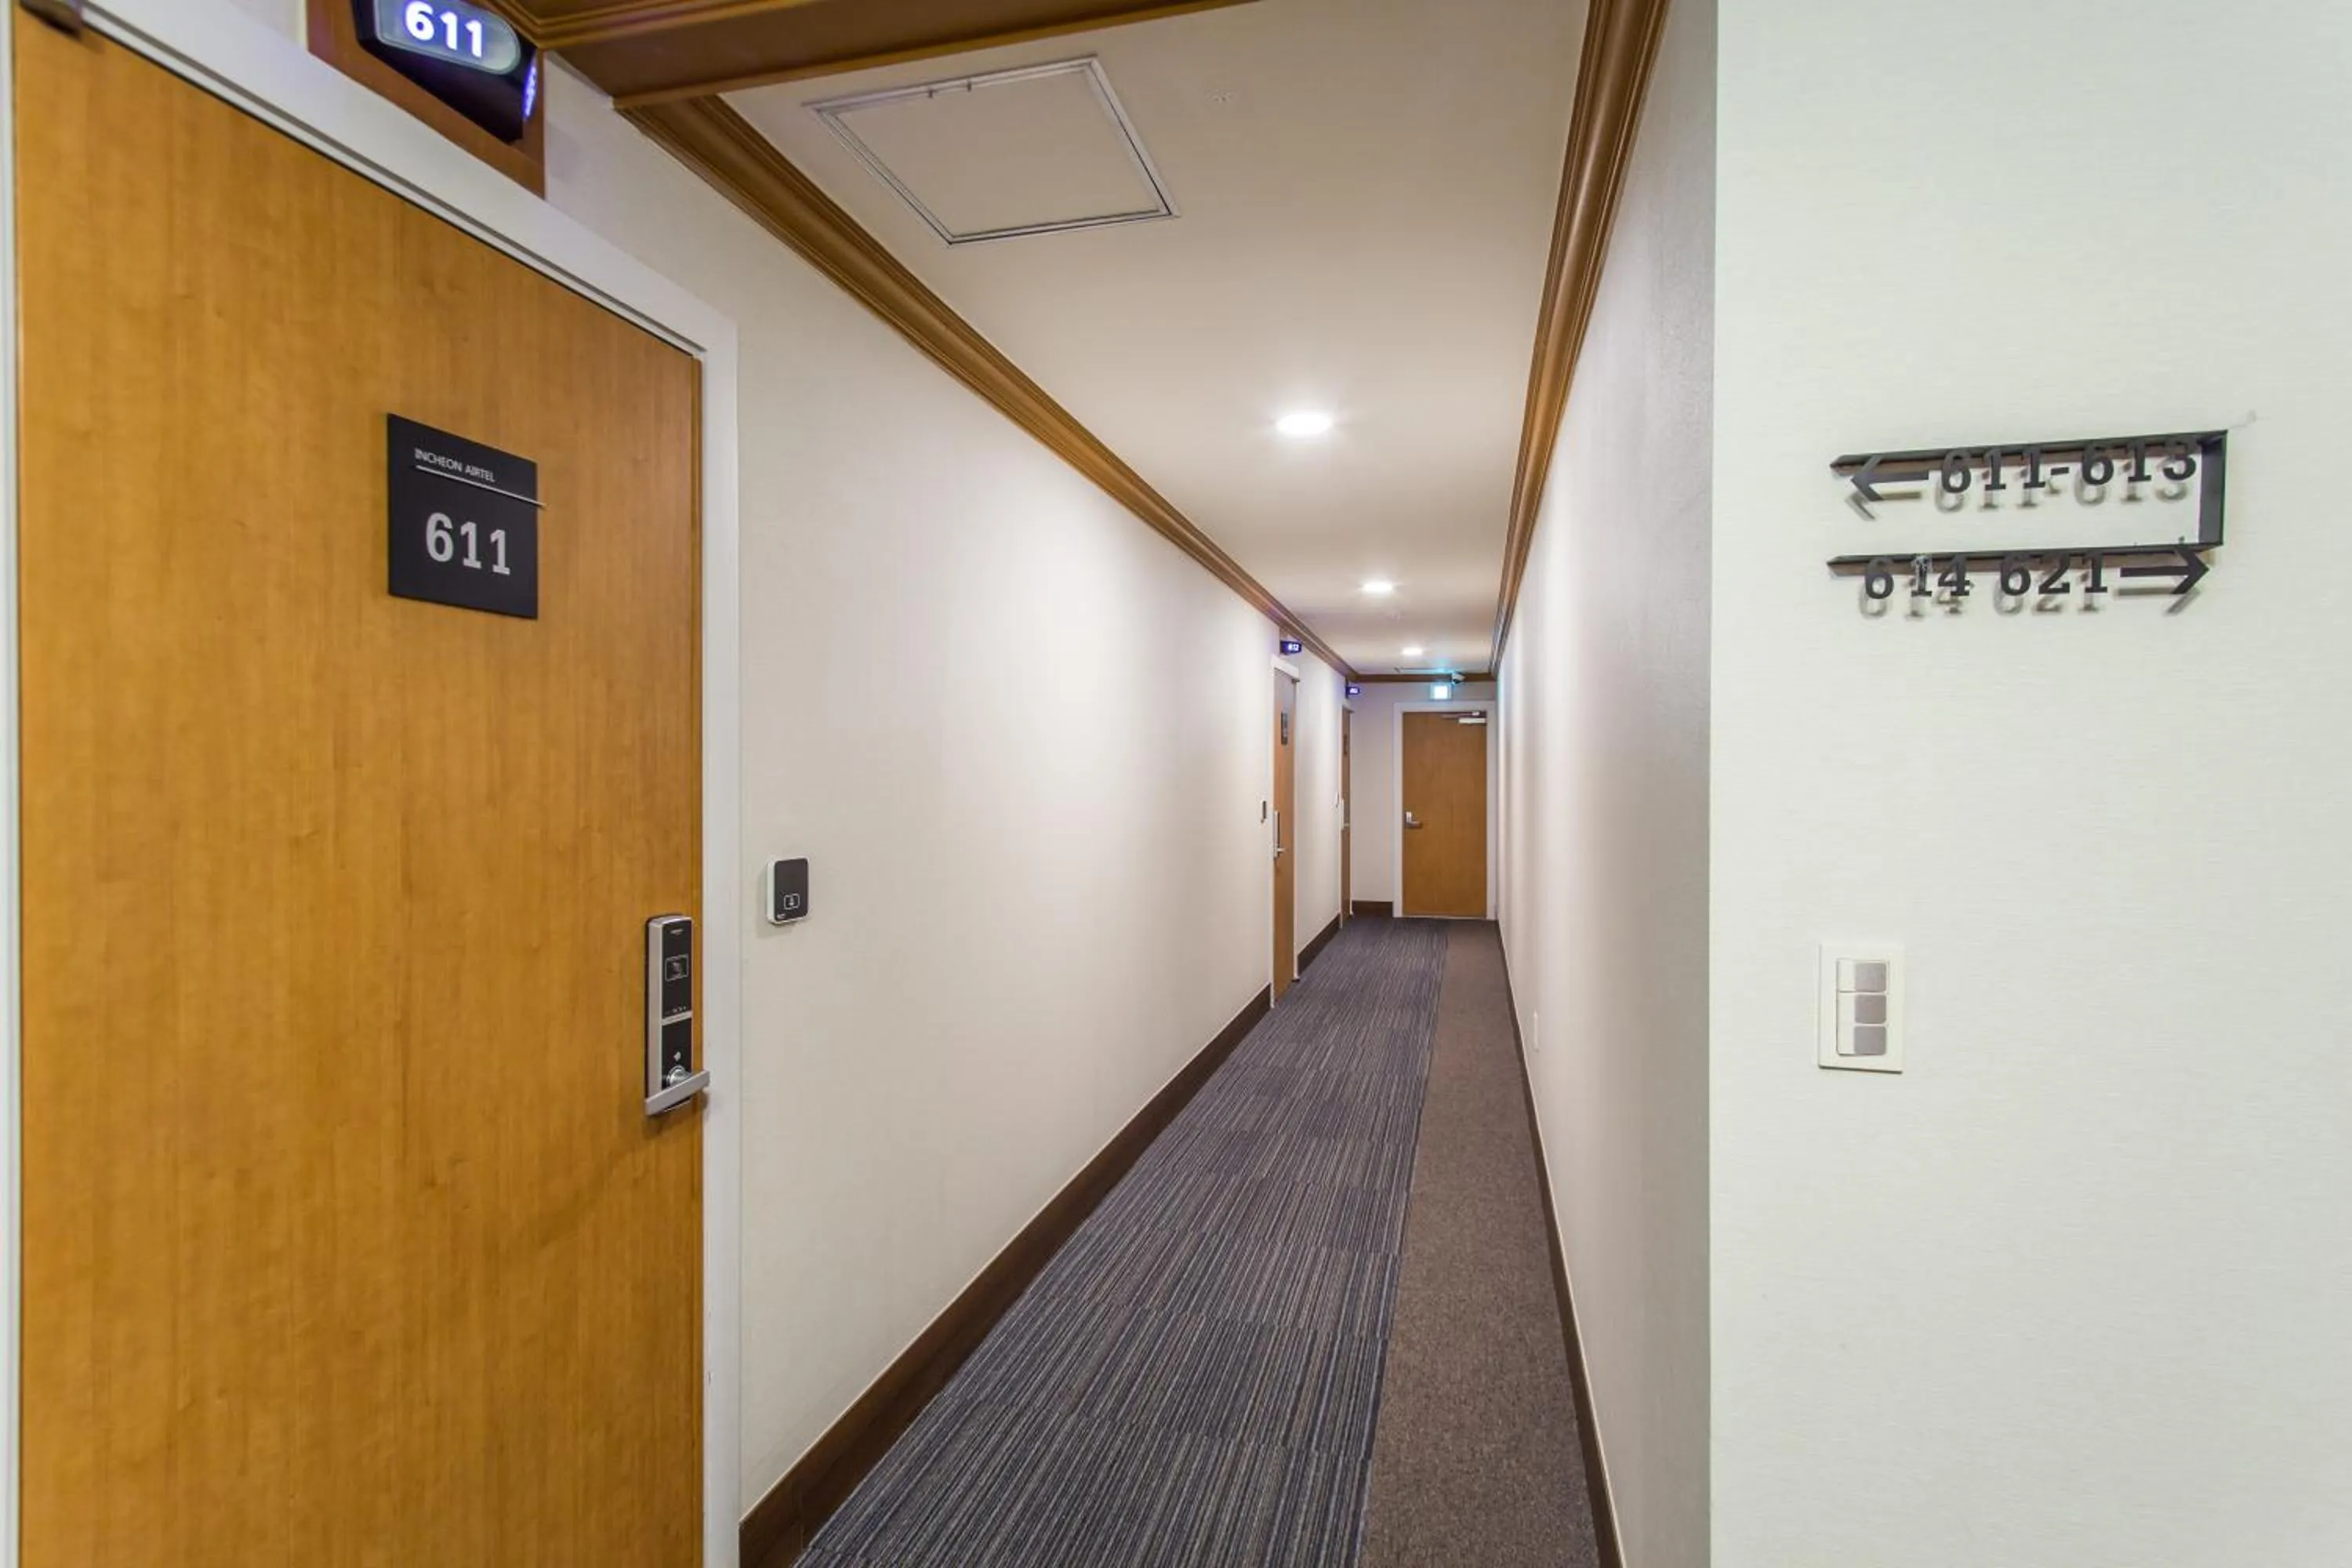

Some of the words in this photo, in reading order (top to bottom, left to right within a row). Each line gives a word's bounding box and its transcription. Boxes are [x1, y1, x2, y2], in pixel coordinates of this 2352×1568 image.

[405, 0, 483, 58] 611
[414, 448, 463, 472] INCHEON
[465, 464, 495, 482] AIRTEL
[1941, 437, 2196, 494] 611-613
[426, 512, 510, 575] 611
[1865, 551, 1970, 599] 614
[2000, 546, 2108, 596] 621
